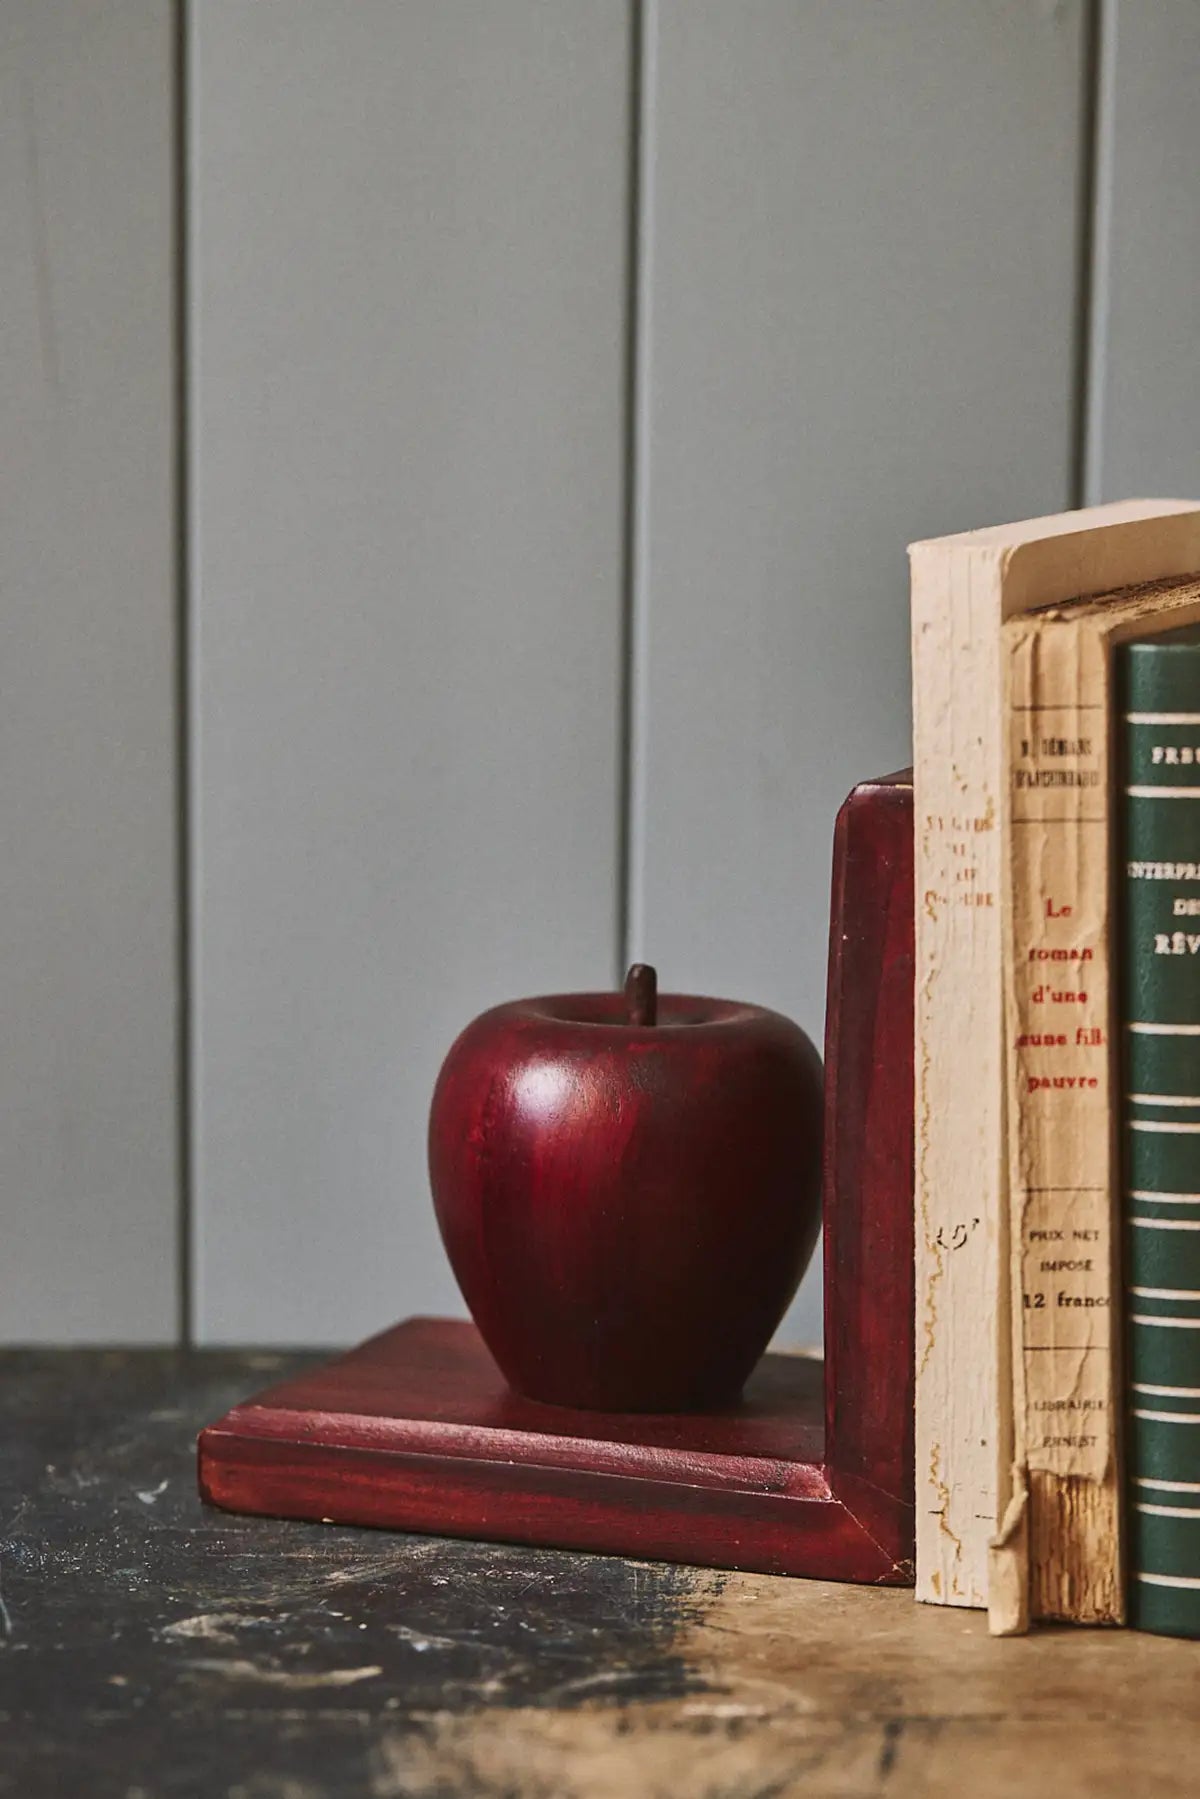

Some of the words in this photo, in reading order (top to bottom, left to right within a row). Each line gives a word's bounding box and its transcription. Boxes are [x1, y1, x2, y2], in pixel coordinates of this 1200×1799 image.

[1046, 900, 1073, 918] Le
[1028, 948, 1094, 962] roman
[1031, 985, 1089, 1004] d'une
[1075, 1027, 1107, 1046] fill
[1026, 1076, 1099, 1094] pauvre
[1029, 1230, 1063, 1242] PRIX
[1073, 1230, 1099, 1241] NET
[1023, 1293, 1046, 1309] 12
